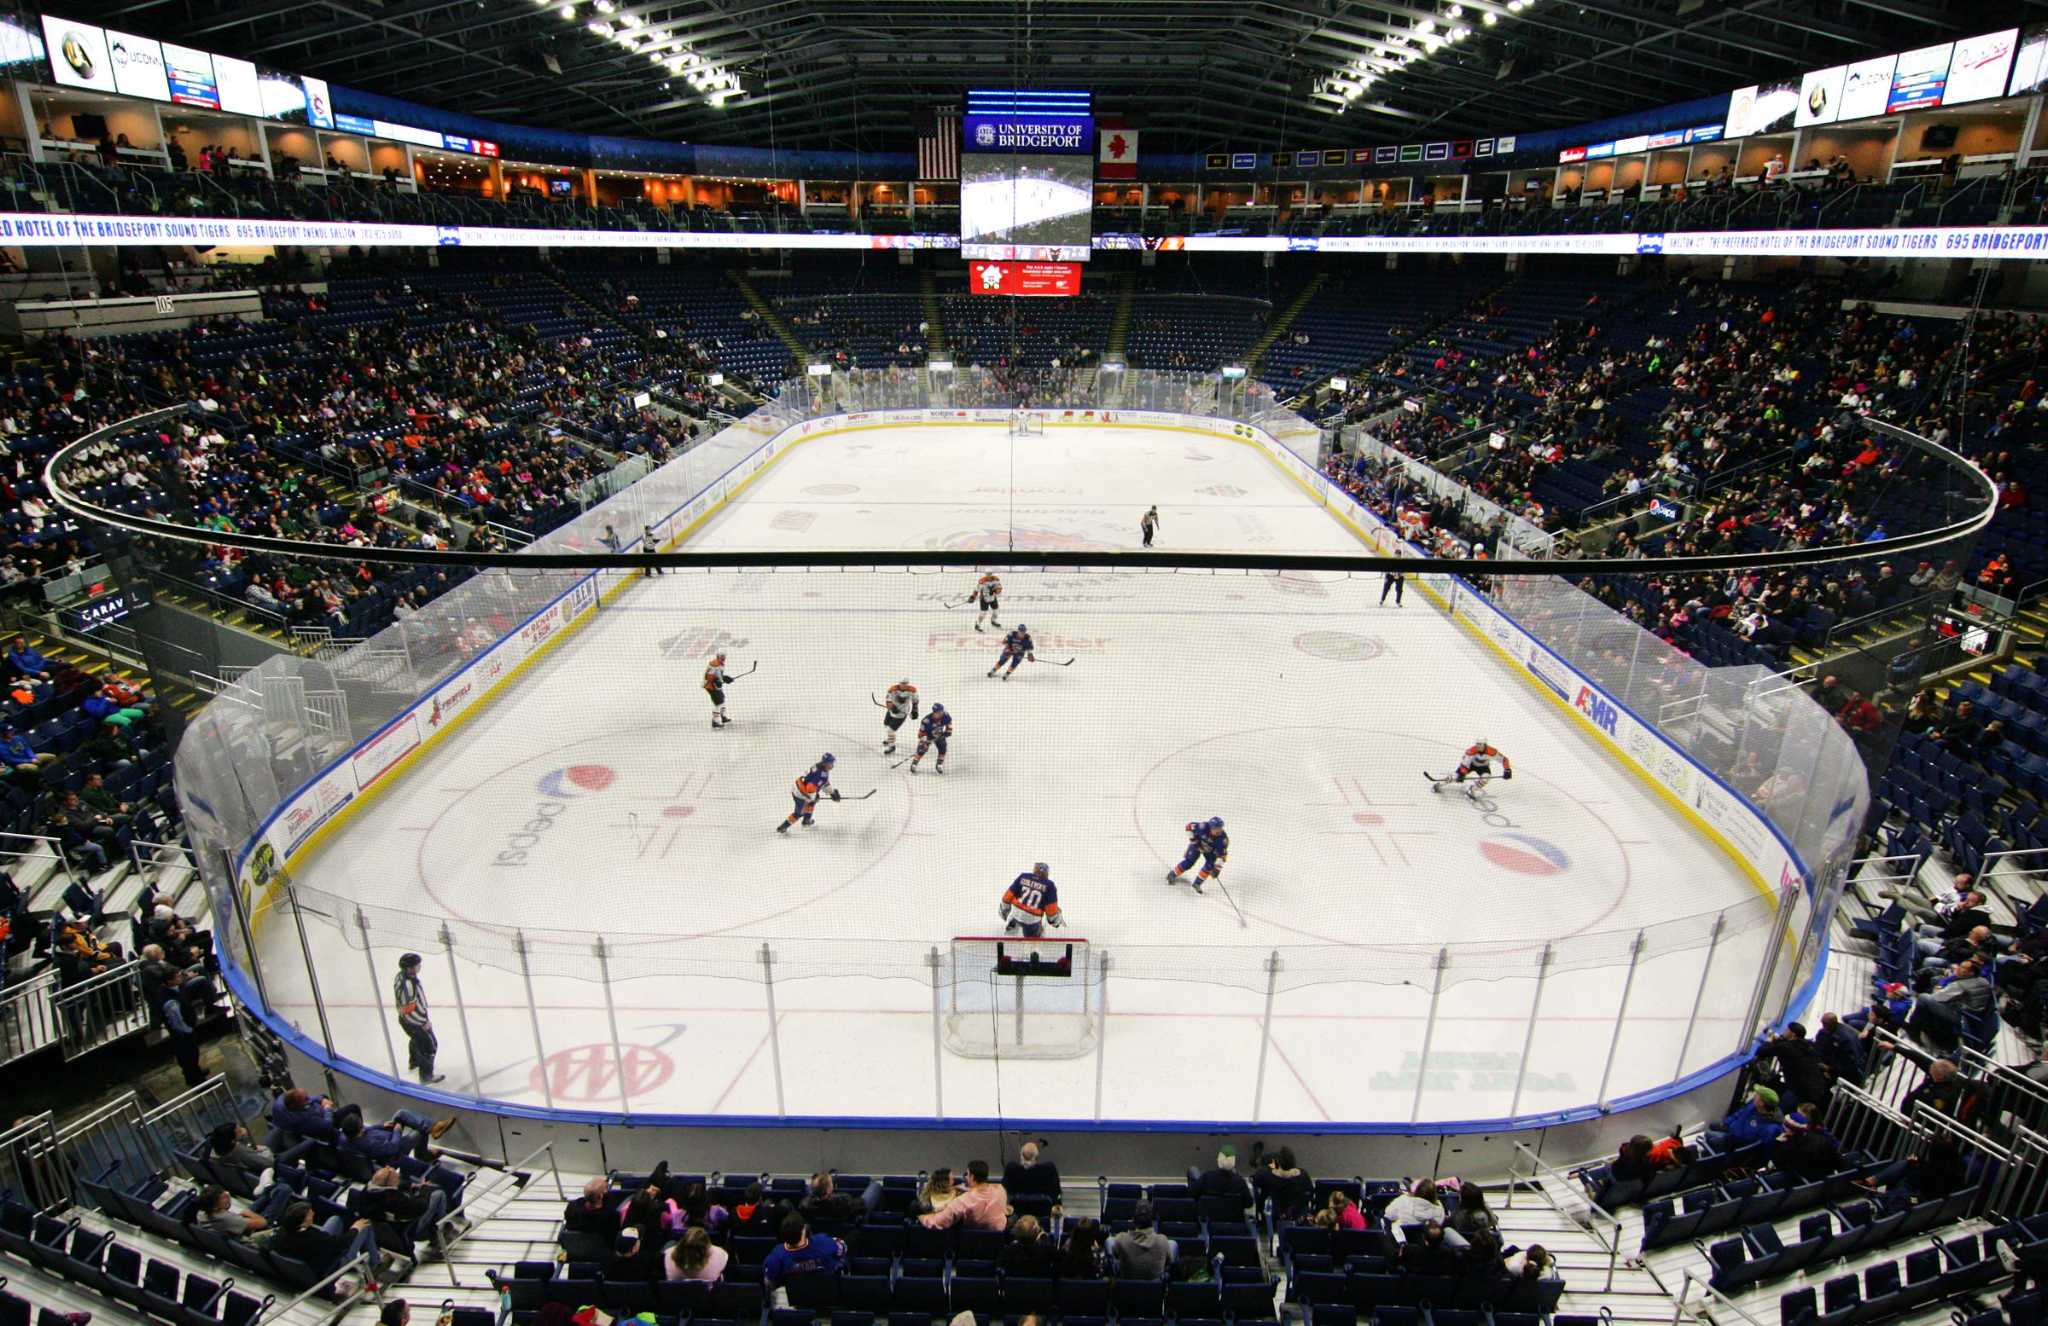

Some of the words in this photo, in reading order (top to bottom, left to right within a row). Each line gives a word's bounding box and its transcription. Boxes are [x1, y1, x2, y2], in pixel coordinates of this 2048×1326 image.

[999, 124, 1066, 135] UNIVERSITY
[1067, 125, 1083, 136] OF
[999, 135, 1082, 147] BRIDGEPORT
[16, 219, 54, 237] HOTEL
[57, 220, 71, 237] OF
[73, 221, 96, 237] THE
[98, 222, 162, 238] BRIDGEPORT
[164, 223, 198, 238] SOUND
[199, 223, 231, 238] TIGERS
[236, 225, 253, 238] 695
[255, 225, 300, 238] BRIDGEPORT
[1722, 235, 1759, 248] PREFERRED
[1761, 235, 1781, 249] HOTEL
[1783, 235, 1793, 249] OF
[1796, 235, 1808, 249] THE
[1811, 234, 1865, 249] BRIDGEPORT
[1866, 234, 1898, 249] SOUND
[1902, 234, 1938, 249] TIGERS
[1946, 233, 1970, 250] 695
[1971, 232, 2048, 251] BRIDGEPORT
[157, 296, 174, 313] 105
[928, 630, 1109, 650] Frotier
[490, 802, 567, 867] pepsi
[1019, 886, 1042, 909] 70
